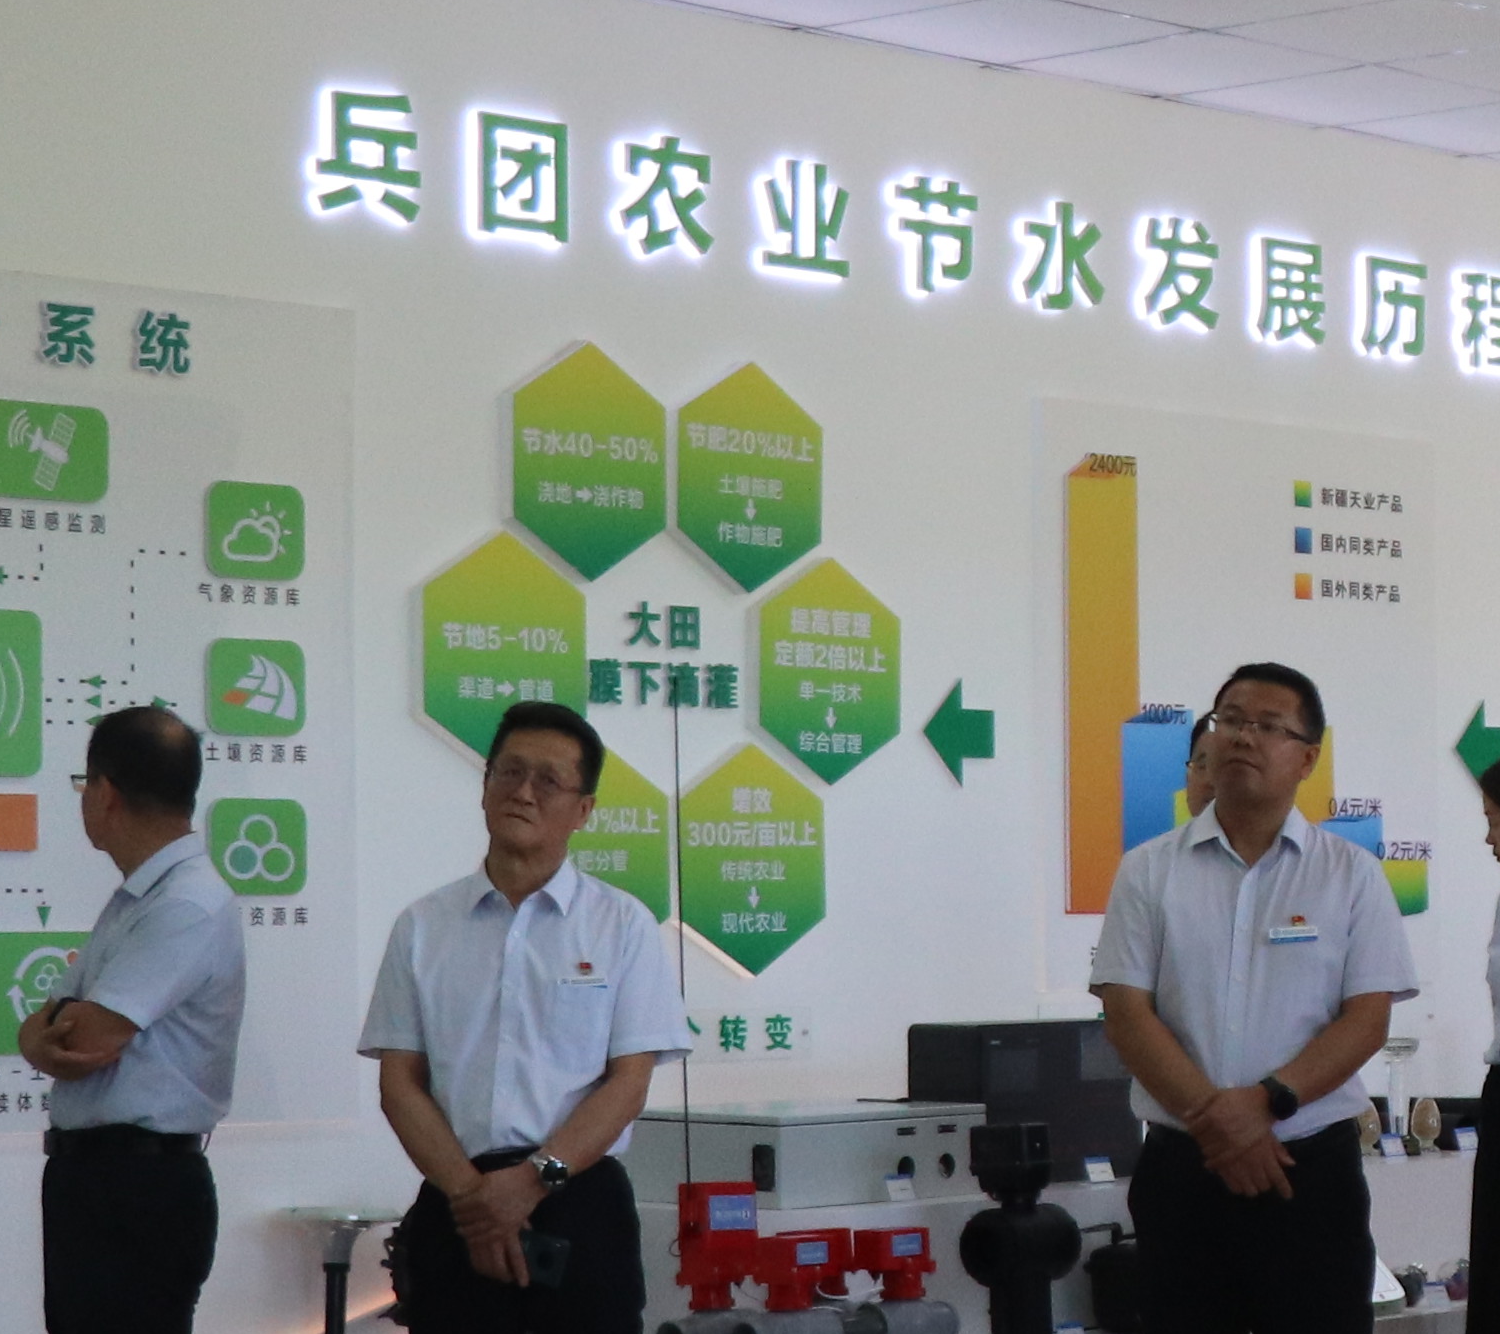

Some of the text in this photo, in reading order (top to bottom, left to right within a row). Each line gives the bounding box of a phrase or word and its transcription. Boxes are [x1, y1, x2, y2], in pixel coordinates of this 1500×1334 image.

[522, 427, 658, 464] 节水40-50%
[687, 422, 814, 463] 节肥20%以上
[1089, 453, 1137, 477] 2400元
[1321, 487, 1403, 513] 新疆天业产品
[717, 522, 783, 547] 作物施肥
[1321, 533, 1403, 558] 国内同类产品
[199, 583, 301, 606] 气象资源库
[1321, 579, 1401, 603] 国外同类产品
[626, 601, 700, 650] 大田
[792, 607, 872, 638] 提高管理
[442, 622, 569, 654] 节地5-10%
[774, 640, 887, 673] 定额2倍以上
[519, 678, 554, 701] 管道
[589, 658, 739, 708] 膜下滴灌
[800, 681, 862, 703] 单一技术
[1142, 703, 1187, 724] 1000元
[205, 743, 307, 764] 土壤资源库
[800, 731, 862, 754] 综合管理
[732, 787, 773, 813] 增效
[574, 807, 660, 833] 0%以上
[688, 821, 817, 847] 300元/亩以上
[721, 860, 785, 881] 传统农业
[238, 907, 308, 926] 资源库
[721, 913, 787, 934] 现代农业
